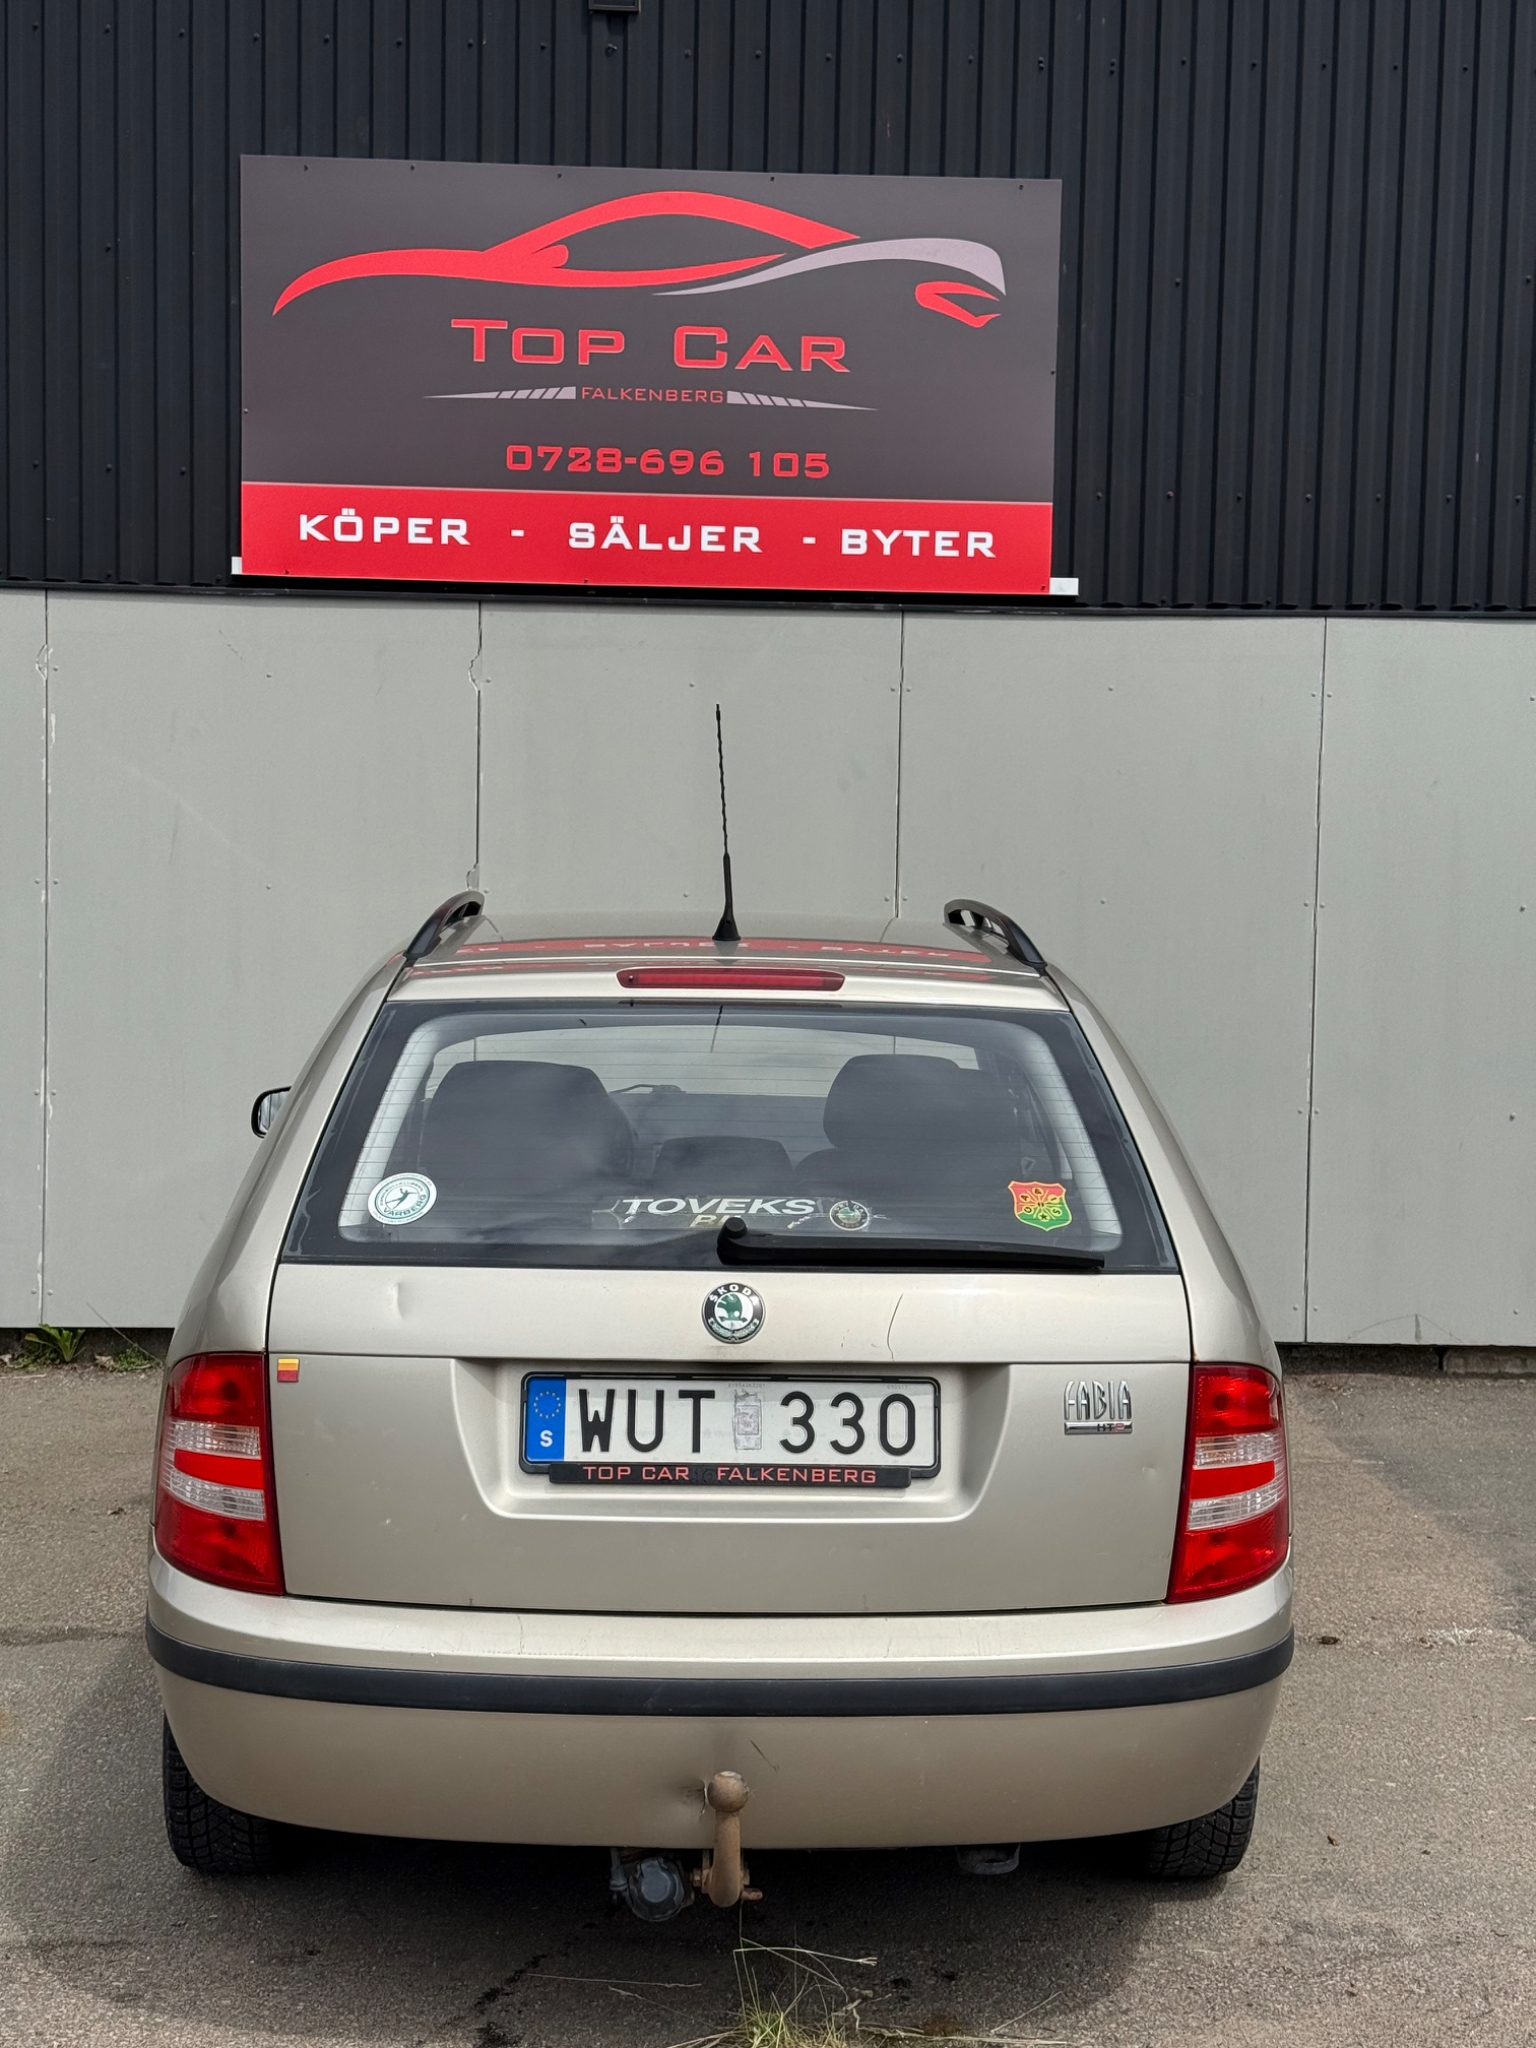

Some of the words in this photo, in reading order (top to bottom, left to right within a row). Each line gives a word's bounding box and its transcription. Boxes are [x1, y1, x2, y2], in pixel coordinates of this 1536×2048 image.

[581, 386, 724, 404] FALKENBERG
[506, 444, 725, 476] 0728-696
[749, 451, 830, 479] 105
[299, 508, 470, 545] KÖPER
[568, 515, 762, 553] SÄLJER
[841, 528, 996, 558] BYTER
[622, 1198, 816, 1215] TOVEKS
[709, 1284, 759, 1305] SKOD
[1064, 1380, 1132, 1420] FABIA
[578, 1388, 716, 1453] WUT
[780, 1391, 916, 1456] 330
[1097, 1423, 1125, 1432] HTP
[540, 1430, 553, 1448] S
[584, 1466, 631, 1479] TOP
[642, 1466, 690, 1480] CAR
[717, 1467, 876, 1483] FALKENBERG
